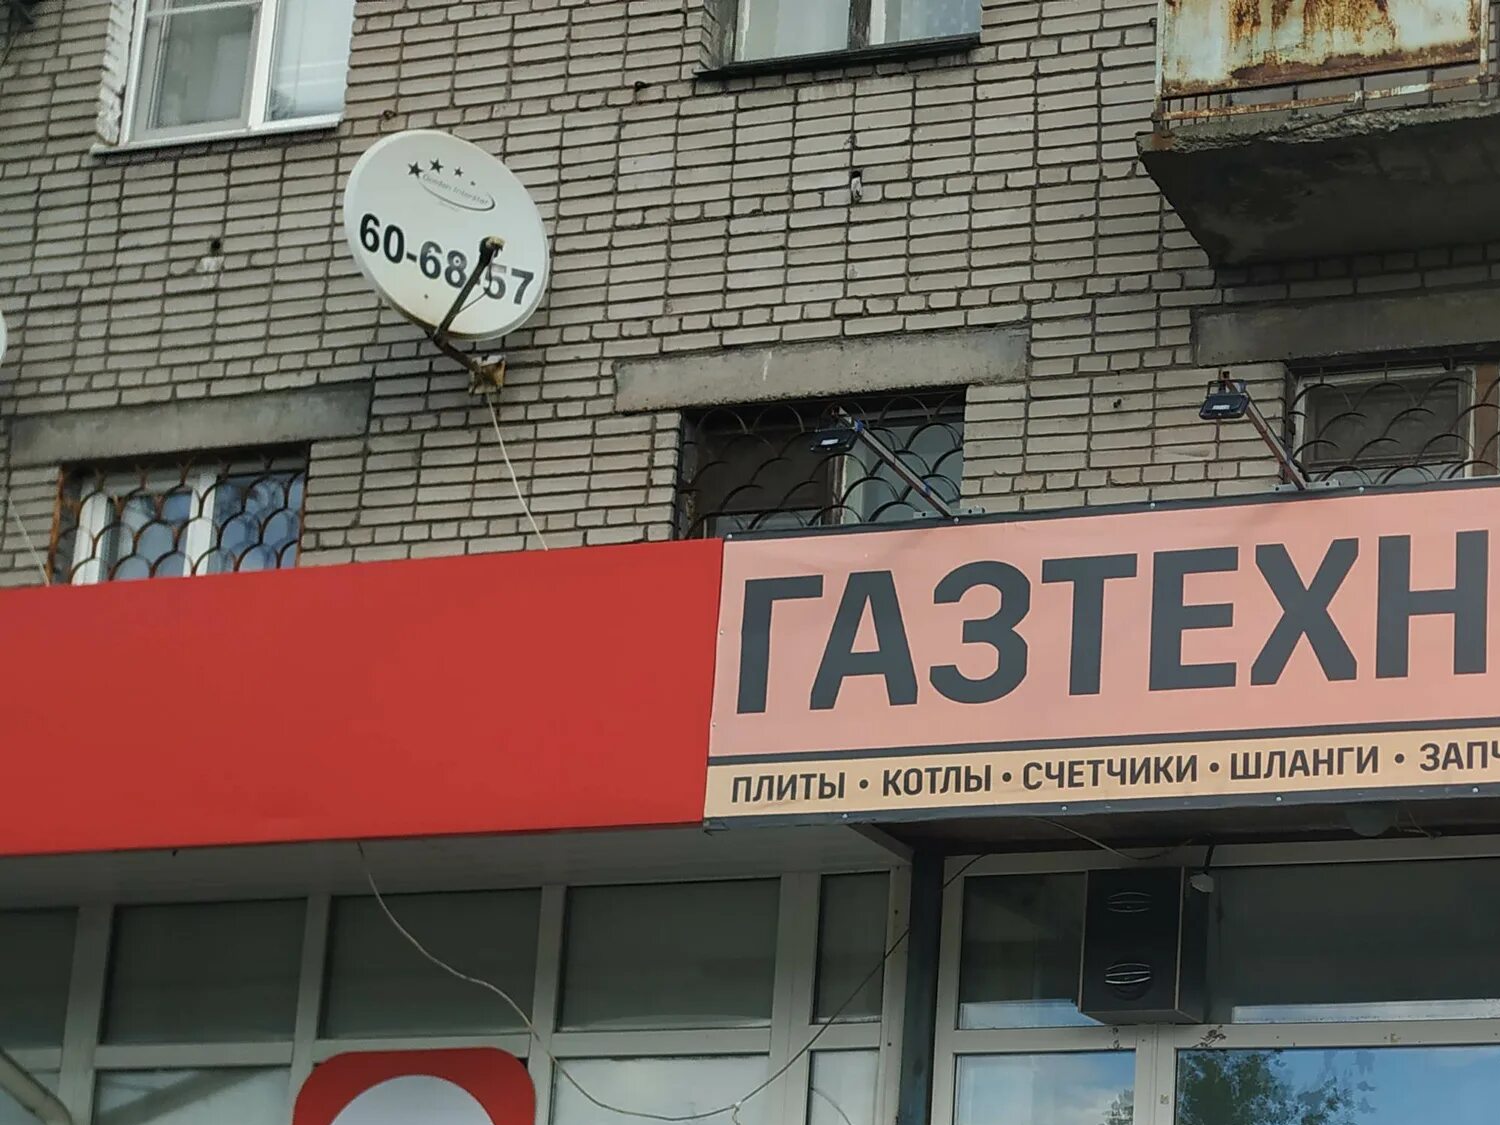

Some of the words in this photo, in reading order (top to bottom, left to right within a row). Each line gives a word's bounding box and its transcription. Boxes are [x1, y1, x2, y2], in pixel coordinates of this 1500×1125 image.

[731, 772, 846, 803] ПЛИТЫ
[881, 764, 992, 797] КОТЛЫ
[1022, 753, 1198, 792] СЧЕТЧИКИ
[1230, 745, 1379, 780] ШЛАНГИ
